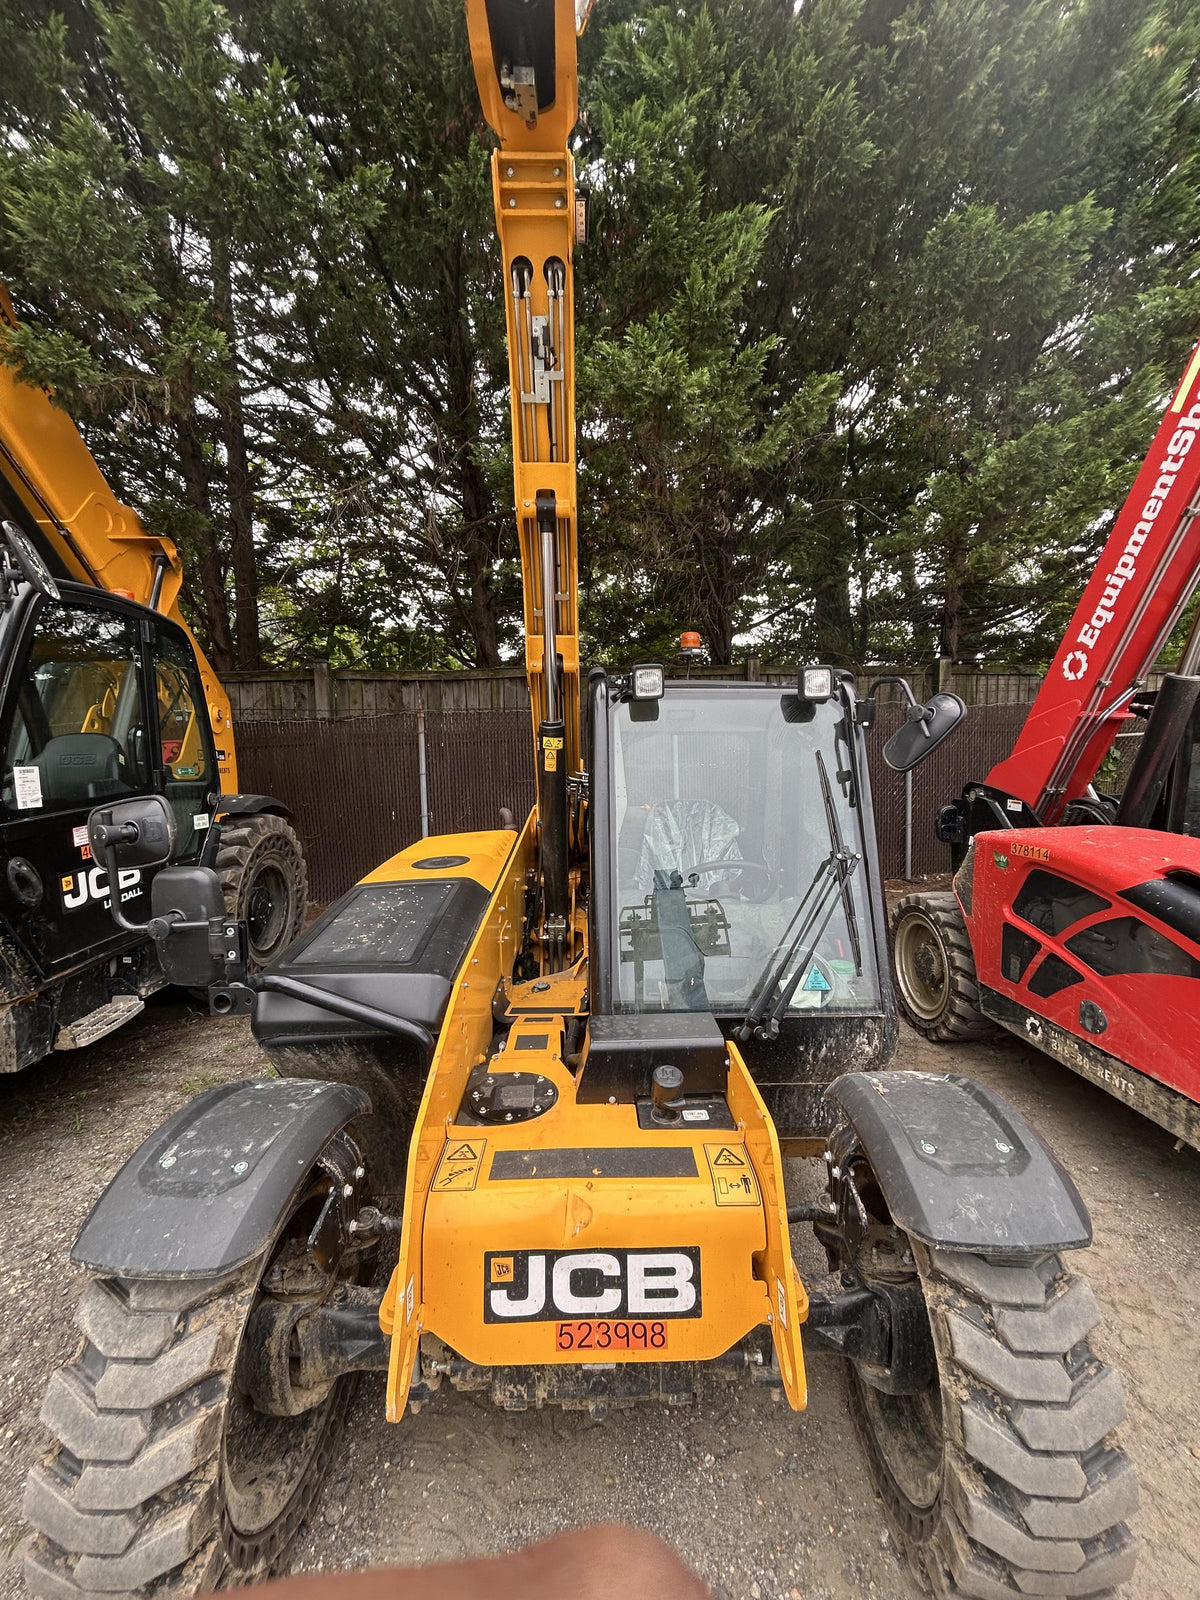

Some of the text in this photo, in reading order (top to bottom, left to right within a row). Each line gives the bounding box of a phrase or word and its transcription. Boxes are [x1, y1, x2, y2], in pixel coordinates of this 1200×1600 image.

[1077, 390, 1200, 649] EquipmentSh
[1012, 843, 1048, 860] 378114
[490, 1253, 697, 1317] JCB
[558, 1321, 666, 1350] 523998
